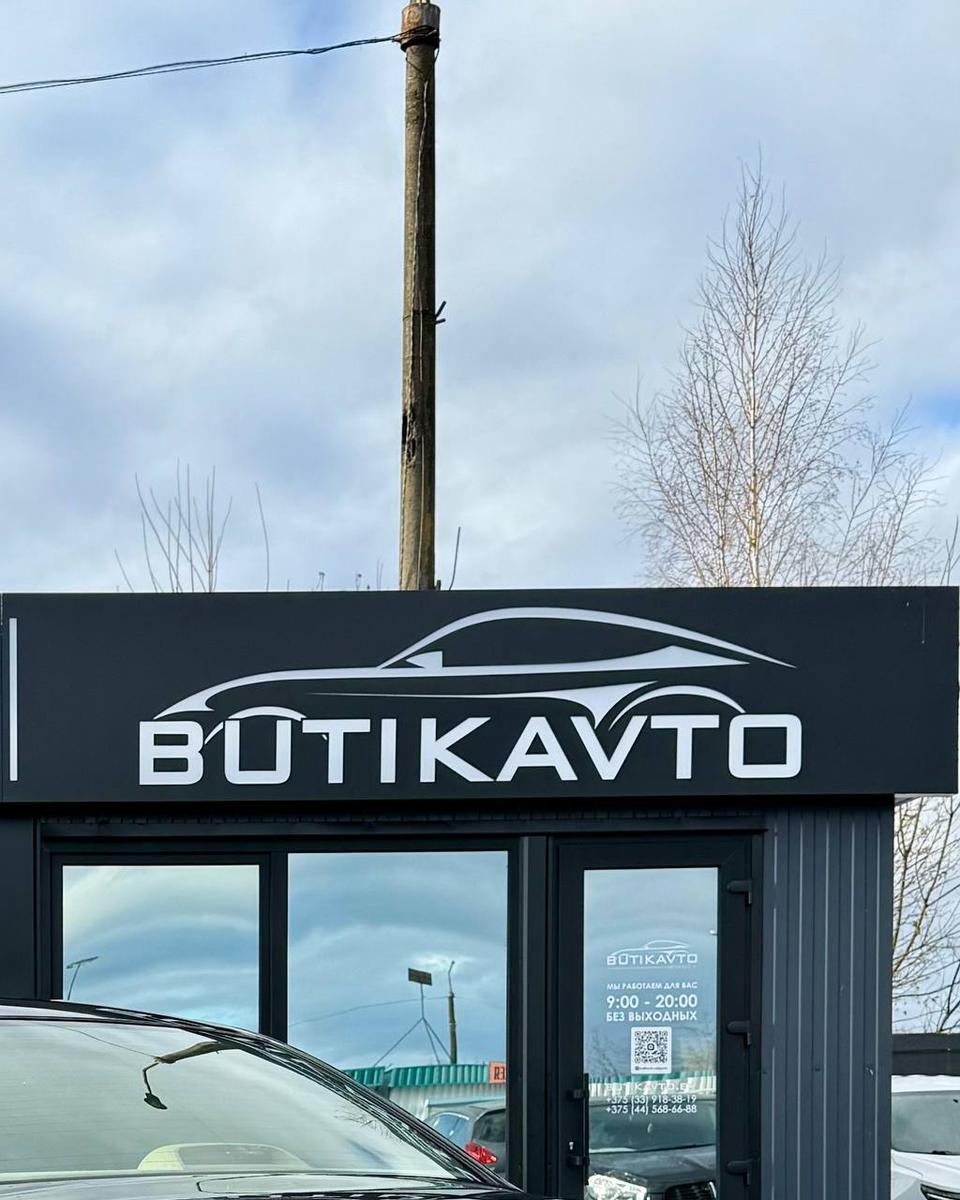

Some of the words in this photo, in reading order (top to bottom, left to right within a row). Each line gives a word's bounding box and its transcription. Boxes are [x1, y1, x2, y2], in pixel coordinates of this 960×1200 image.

[139, 712, 803, 786] BUTIKAVTO
[606, 953, 698, 966] BUTIKAVTO
[622, 982, 662, 990] РАБОТАЕМ
[681, 981, 698, 989] ВАС
[606, 995, 639, 1009] 9:00
[655, 994, 698, 1008] 20:00
[606, 1012, 625, 1022] БЕЗ
[628, 1011, 698, 1022] ВЫХОДНЫХ
[606, 1095, 629, 1104] +375
[631, 1094, 649, 1106] (33)
[651, 1094, 697, 1104] 918-38-19
[606, 1105, 629, 1114] +375
[631, 1104, 649, 1116] (44)
[651, 1104, 698, 1114] 568-66-88
